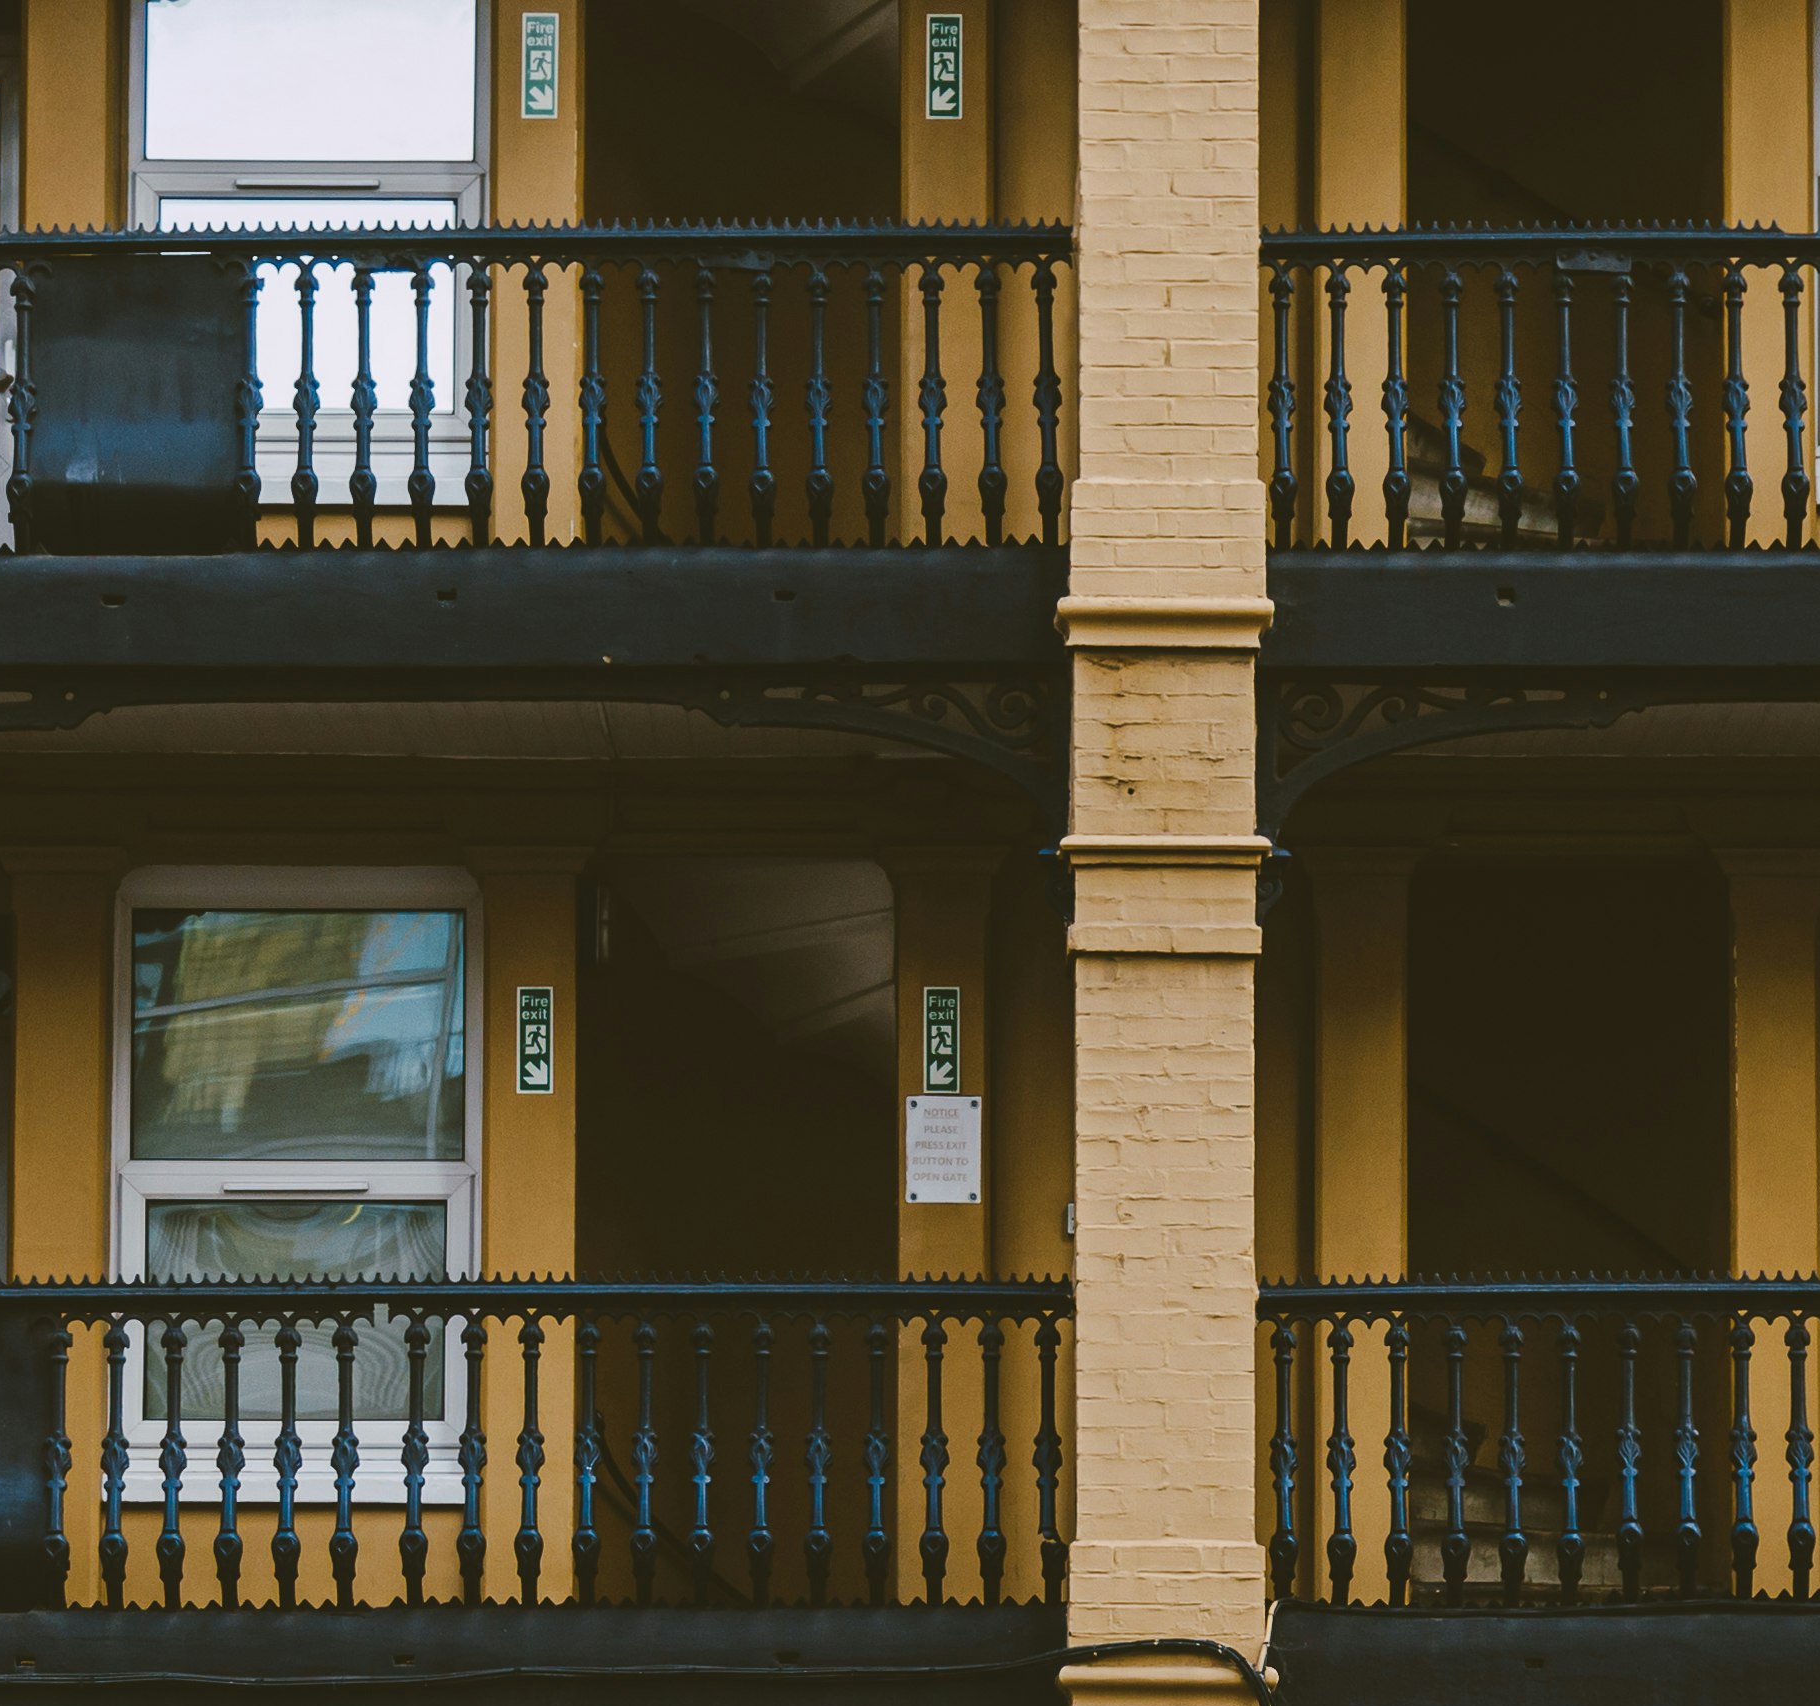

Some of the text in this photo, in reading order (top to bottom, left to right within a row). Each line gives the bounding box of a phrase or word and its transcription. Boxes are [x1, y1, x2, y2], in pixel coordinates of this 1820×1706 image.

[527, 22, 554, 33] Fire
[932, 23, 958, 34] Fire
[527, 34, 552, 46] exit
[932, 36, 957, 47] exit
[522, 995, 548, 1007] Fire
[929, 996, 955, 1007] Fire
[522, 1008, 547, 1020] exit
[929, 1009, 954, 1020] exit
[924, 1109, 958, 1118] NOTICE
[925, 1126, 957, 1134] PLEASE
[946, 1142, 966, 1150] EXIT
[913, 1173, 967, 1181] OPEN GATE
